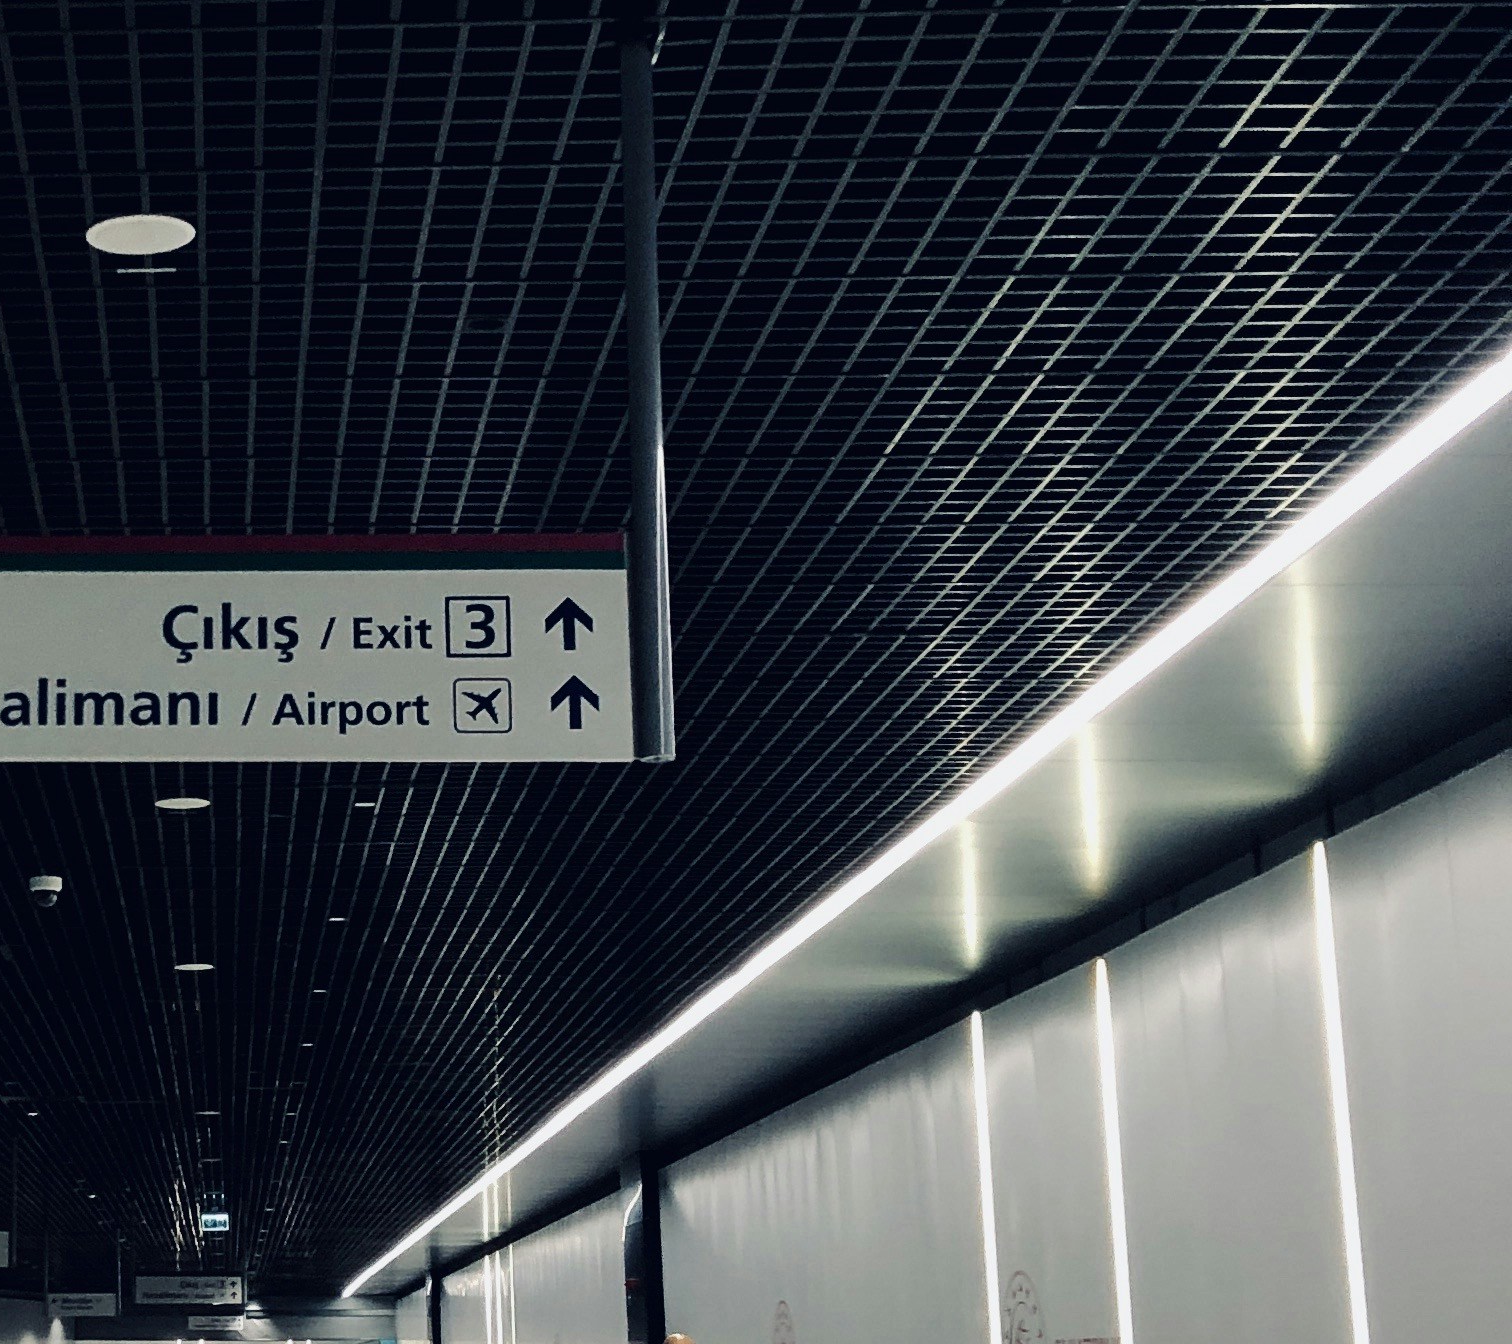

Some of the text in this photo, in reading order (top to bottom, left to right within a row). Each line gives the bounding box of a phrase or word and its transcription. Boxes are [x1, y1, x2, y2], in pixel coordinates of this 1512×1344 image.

[162, 602, 300, 665] Çıkış
[351, 614, 433, 651] Exit
[464, 602, 497, 651] 3
[270, 690, 431, 736] Airport
